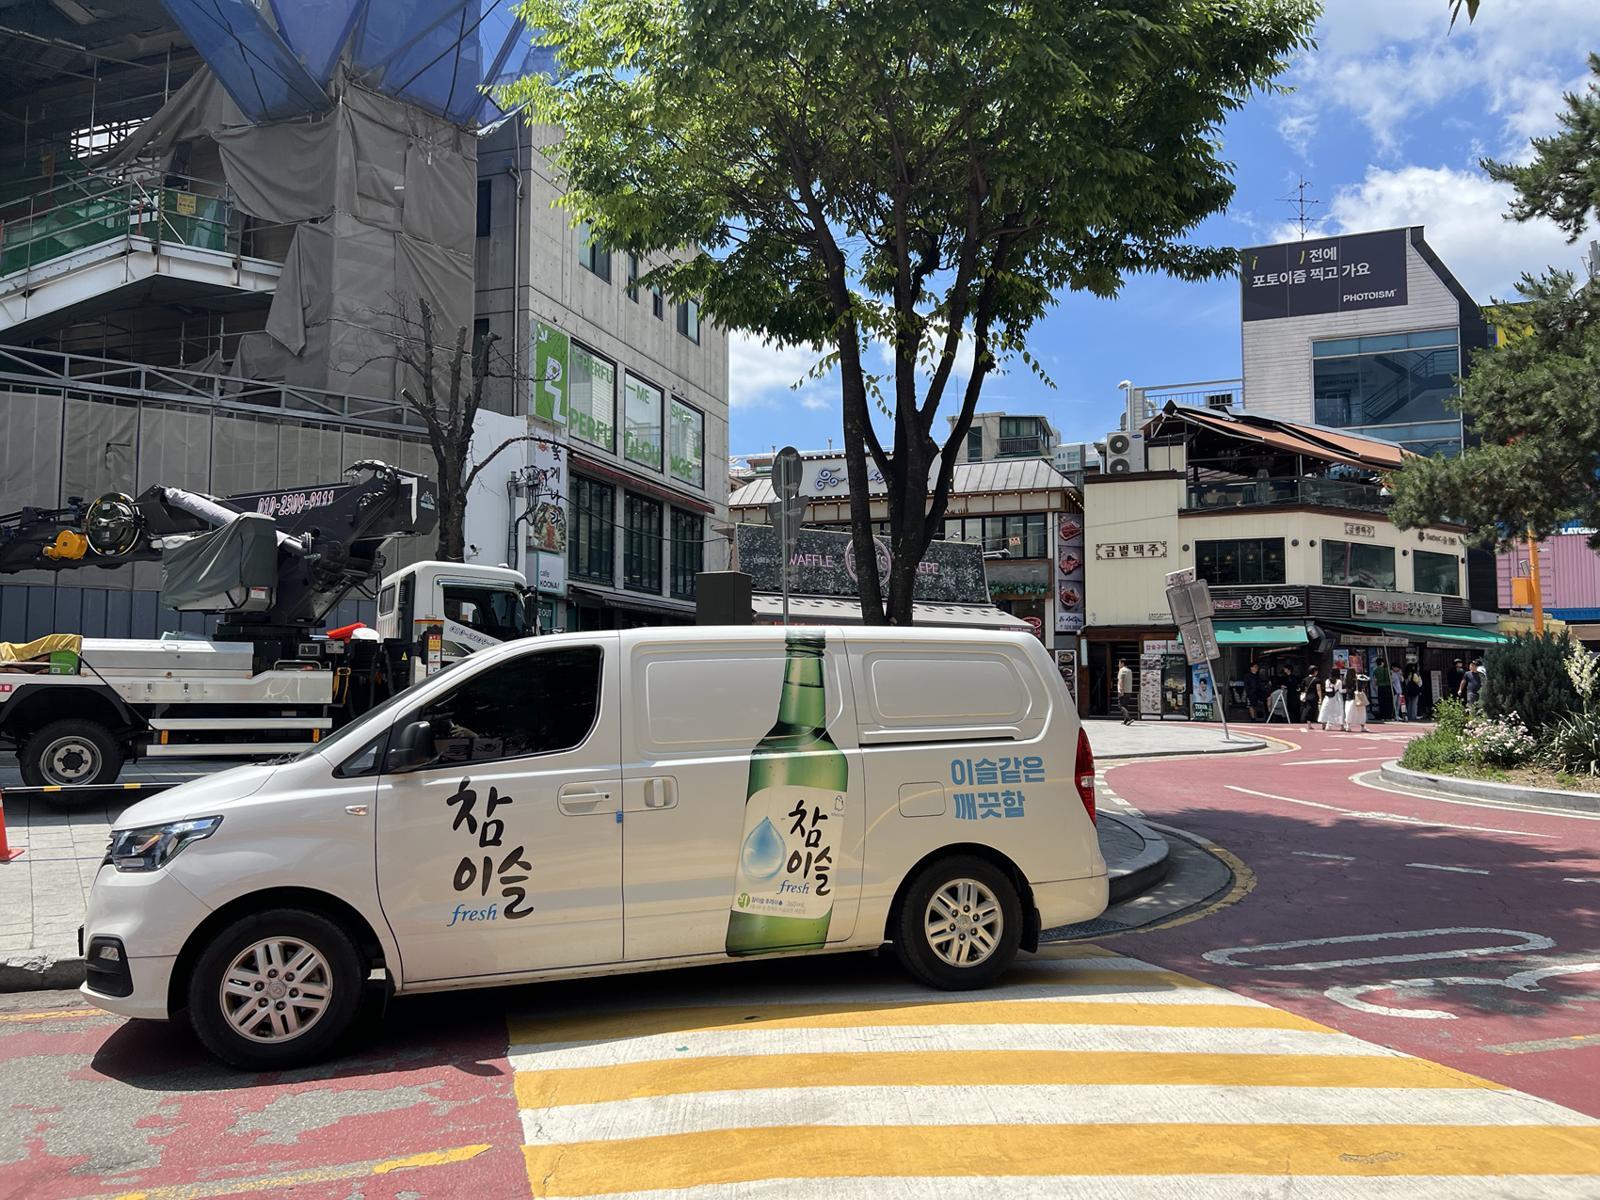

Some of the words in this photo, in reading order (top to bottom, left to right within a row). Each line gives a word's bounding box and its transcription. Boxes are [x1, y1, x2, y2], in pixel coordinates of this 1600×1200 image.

[1309, 246, 1337, 263] 전에
[1252, 269, 1307, 288] 포토이즘
[1310, 265, 1338, 281] 찍고
[1342, 262, 1371, 278] 가요
[1343, 289, 1396, 302] PHOTOISM
[1104, 543, 1159, 558] 금별맥주
[950, 756, 1046, 786] 이슬같은
[446, 775, 514, 848] 참
[953, 789, 1026, 820] 깨끗함
[788, 799, 828, 848] 참
[452, 845, 535, 920] 이슬
[786, 845, 833, 897] 이슬
[776, 879, 810, 895] fresh
[446, 903, 498, 928] fresh
